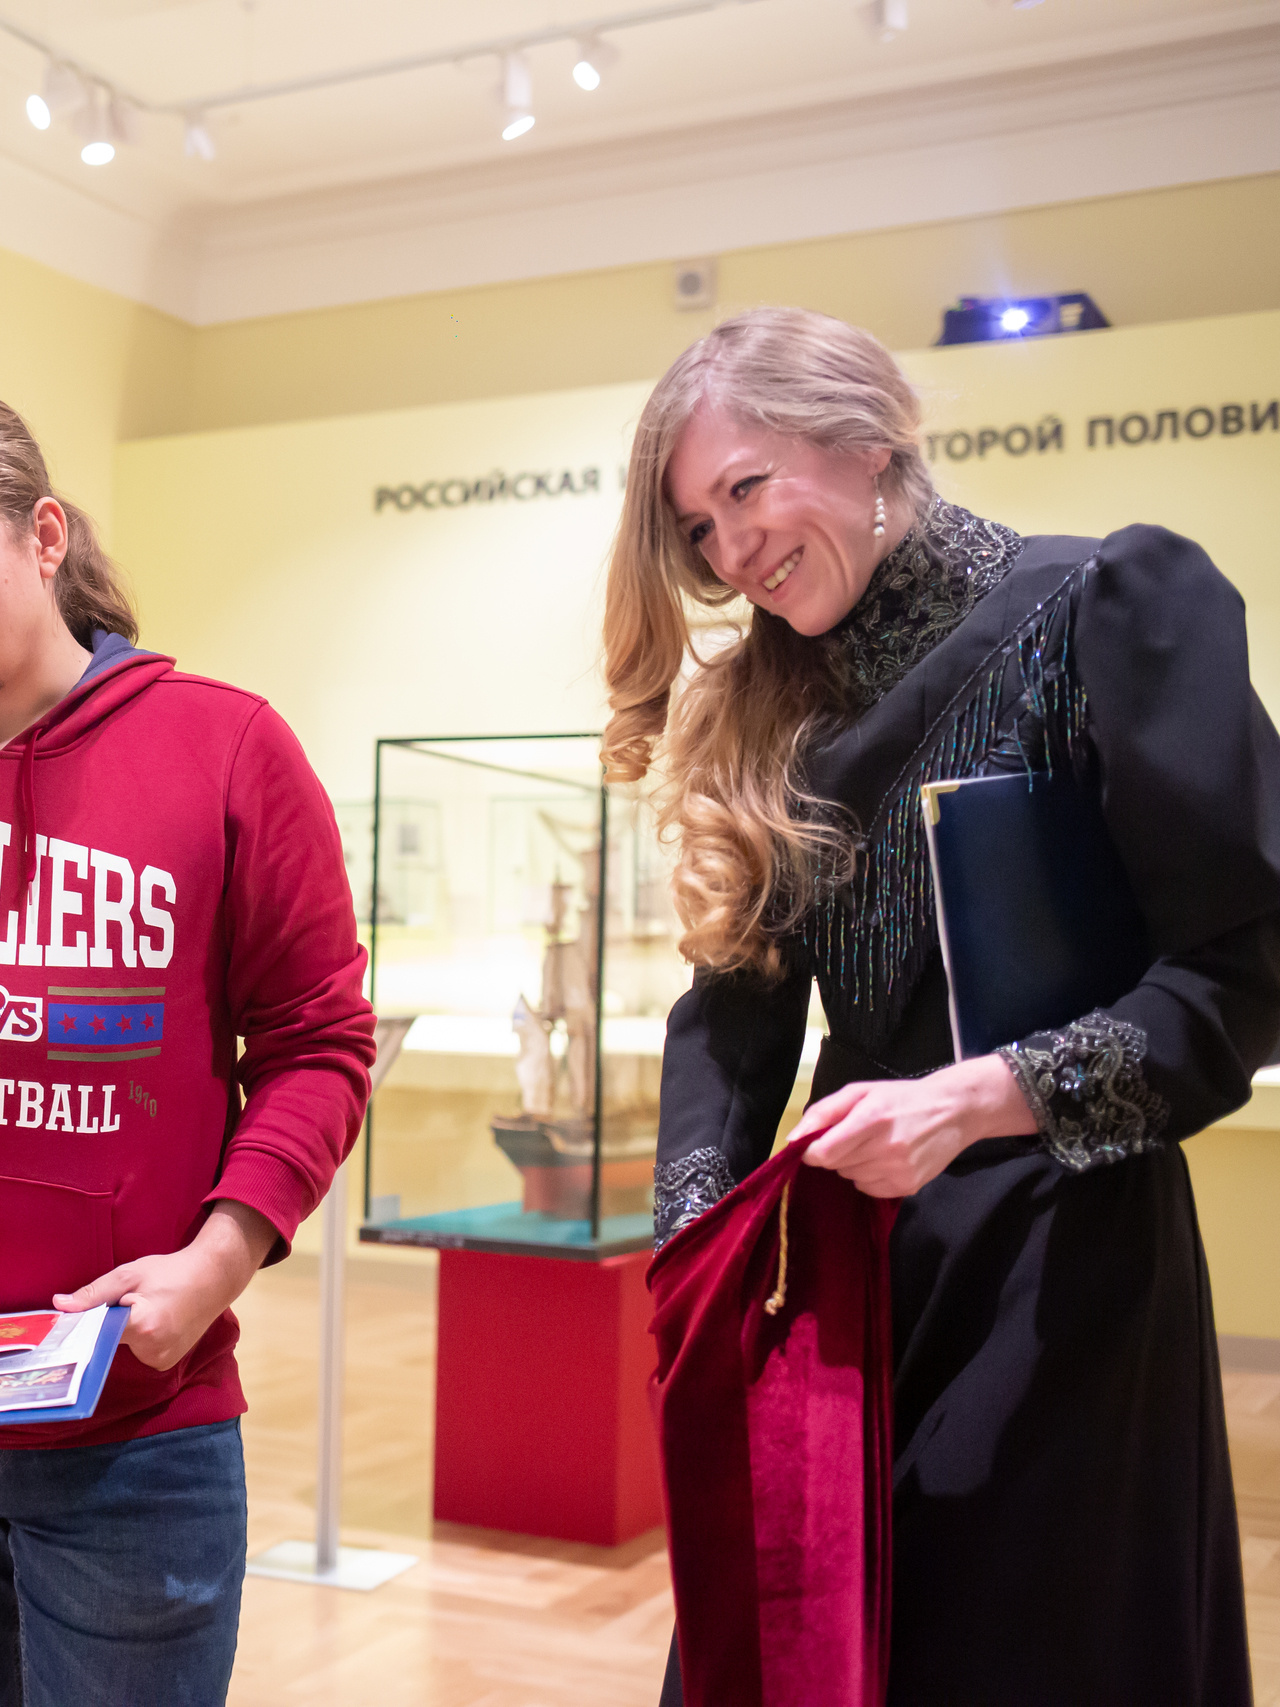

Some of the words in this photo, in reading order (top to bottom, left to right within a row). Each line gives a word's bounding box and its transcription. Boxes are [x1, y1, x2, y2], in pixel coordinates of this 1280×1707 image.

[374, 467, 600, 516] РОССИЙСКАЯ
[926, 412, 1065, 463] ТОРОЙ
[1087, 399, 1280, 448] ПОЛОВИ
[127, 1080, 158, 1118] 1970
